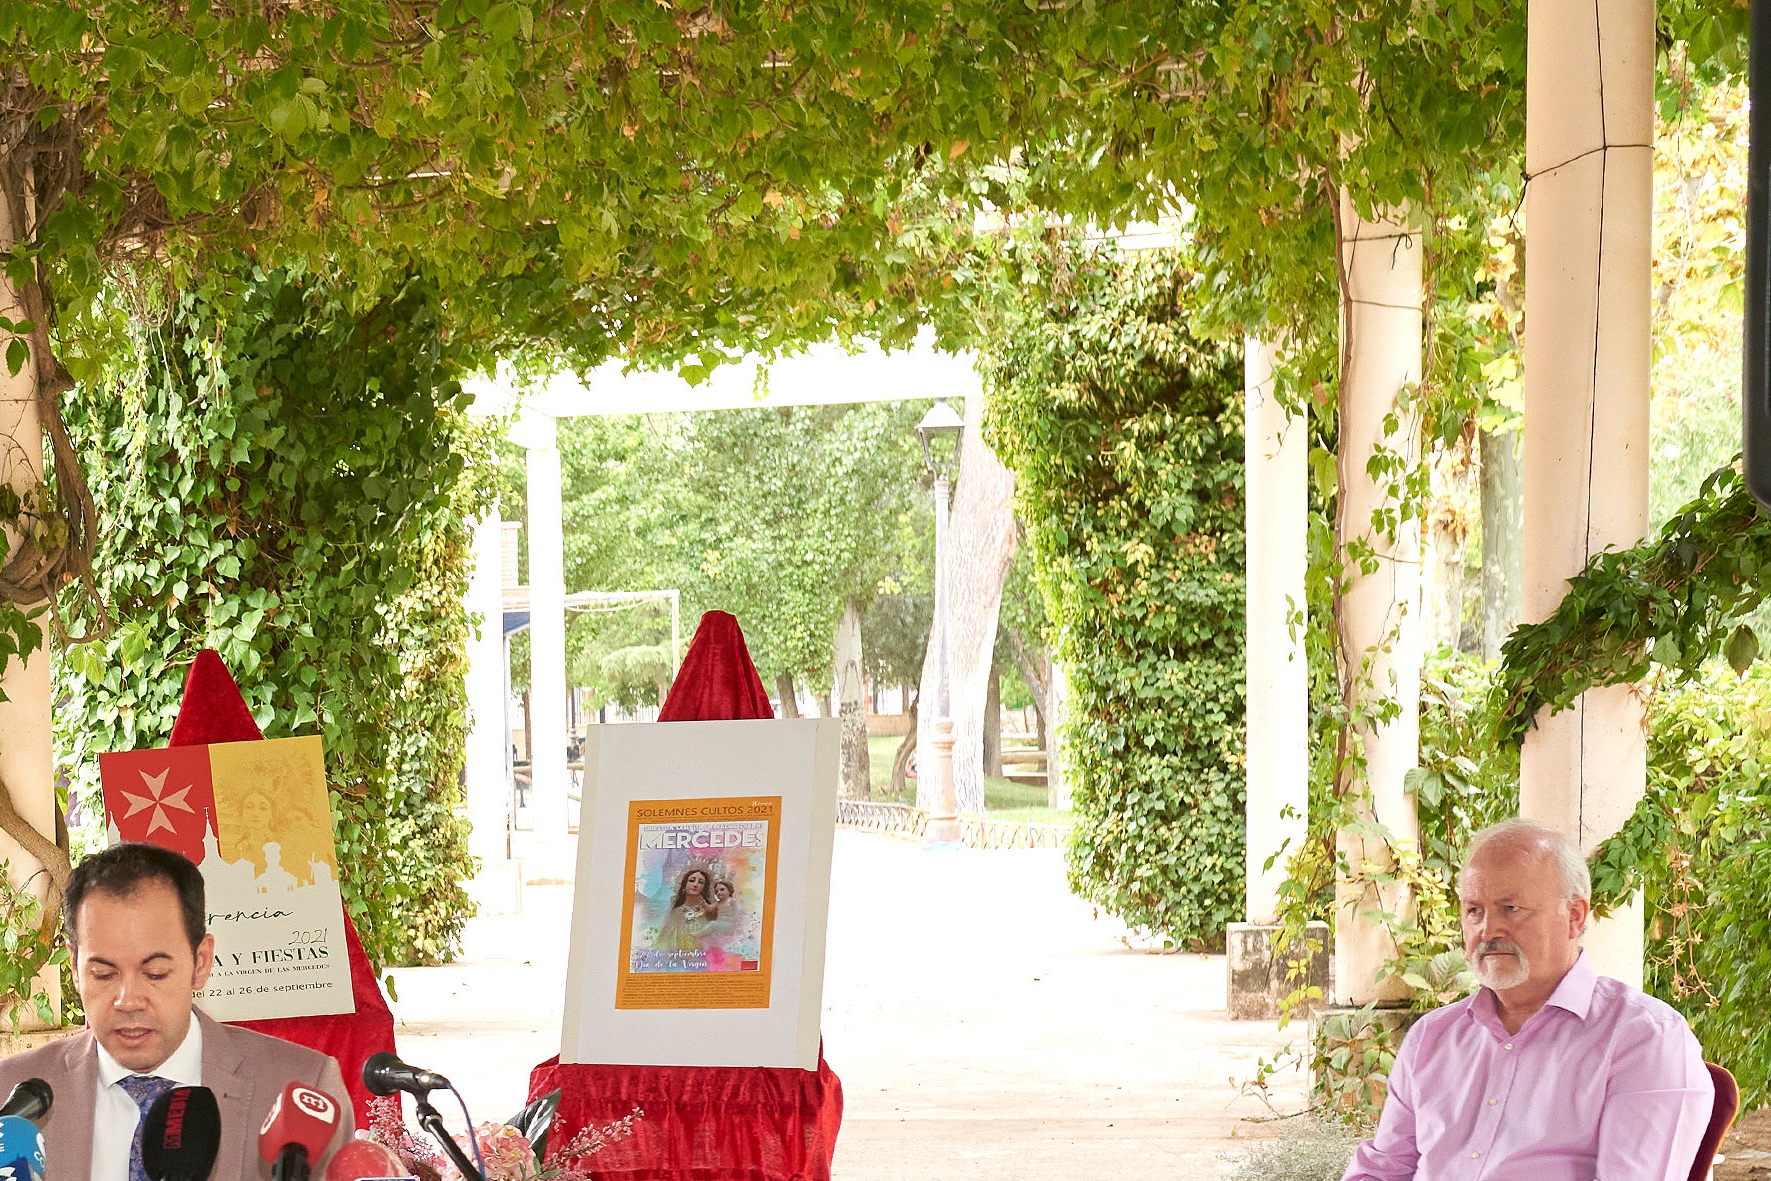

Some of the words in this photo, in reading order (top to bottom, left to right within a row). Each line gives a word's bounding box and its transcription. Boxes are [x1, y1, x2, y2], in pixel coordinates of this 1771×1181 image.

[637, 807, 698, 817] SOLEMNES
[701, 806, 744, 815] CULTOS
[748, 805, 773, 814] 2021
[640, 830, 764, 849] MERCEDES
[205, 907, 293, 925] rencia
[289, 928, 327, 945] 2021
[231, 952, 242, 965] Y
[252, 946, 328, 964] FIESTAS
[653, 949, 662, 957] de
[668, 948, 707, 959] septiembre
[209, 989, 222, 997] 22
[226, 987, 235, 996] al
[239, 986, 253, 995] 26
[256, 985, 269, 993] de
[273, 981, 333, 992] septiembre
